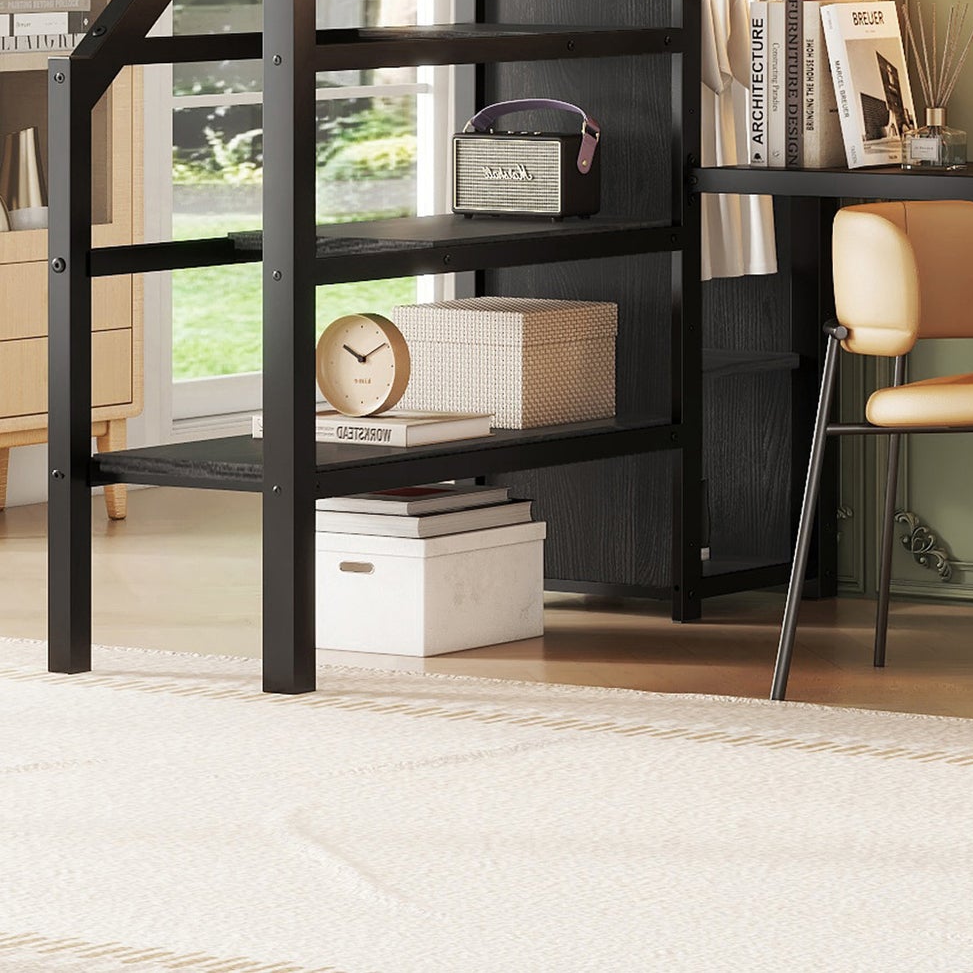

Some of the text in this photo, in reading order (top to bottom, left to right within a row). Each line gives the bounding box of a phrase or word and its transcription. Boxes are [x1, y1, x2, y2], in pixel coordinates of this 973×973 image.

[851, 10, 885, 26] BREUER
[752, 18, 764, 145] ARCHITECTURE
[788, 0, 798, 166] FURNITURE DESIGN
[806, 39, 814, 130] BRINGING THE HOUSE HOME
[834, 60, 850, 119] MARCEL BREUER
